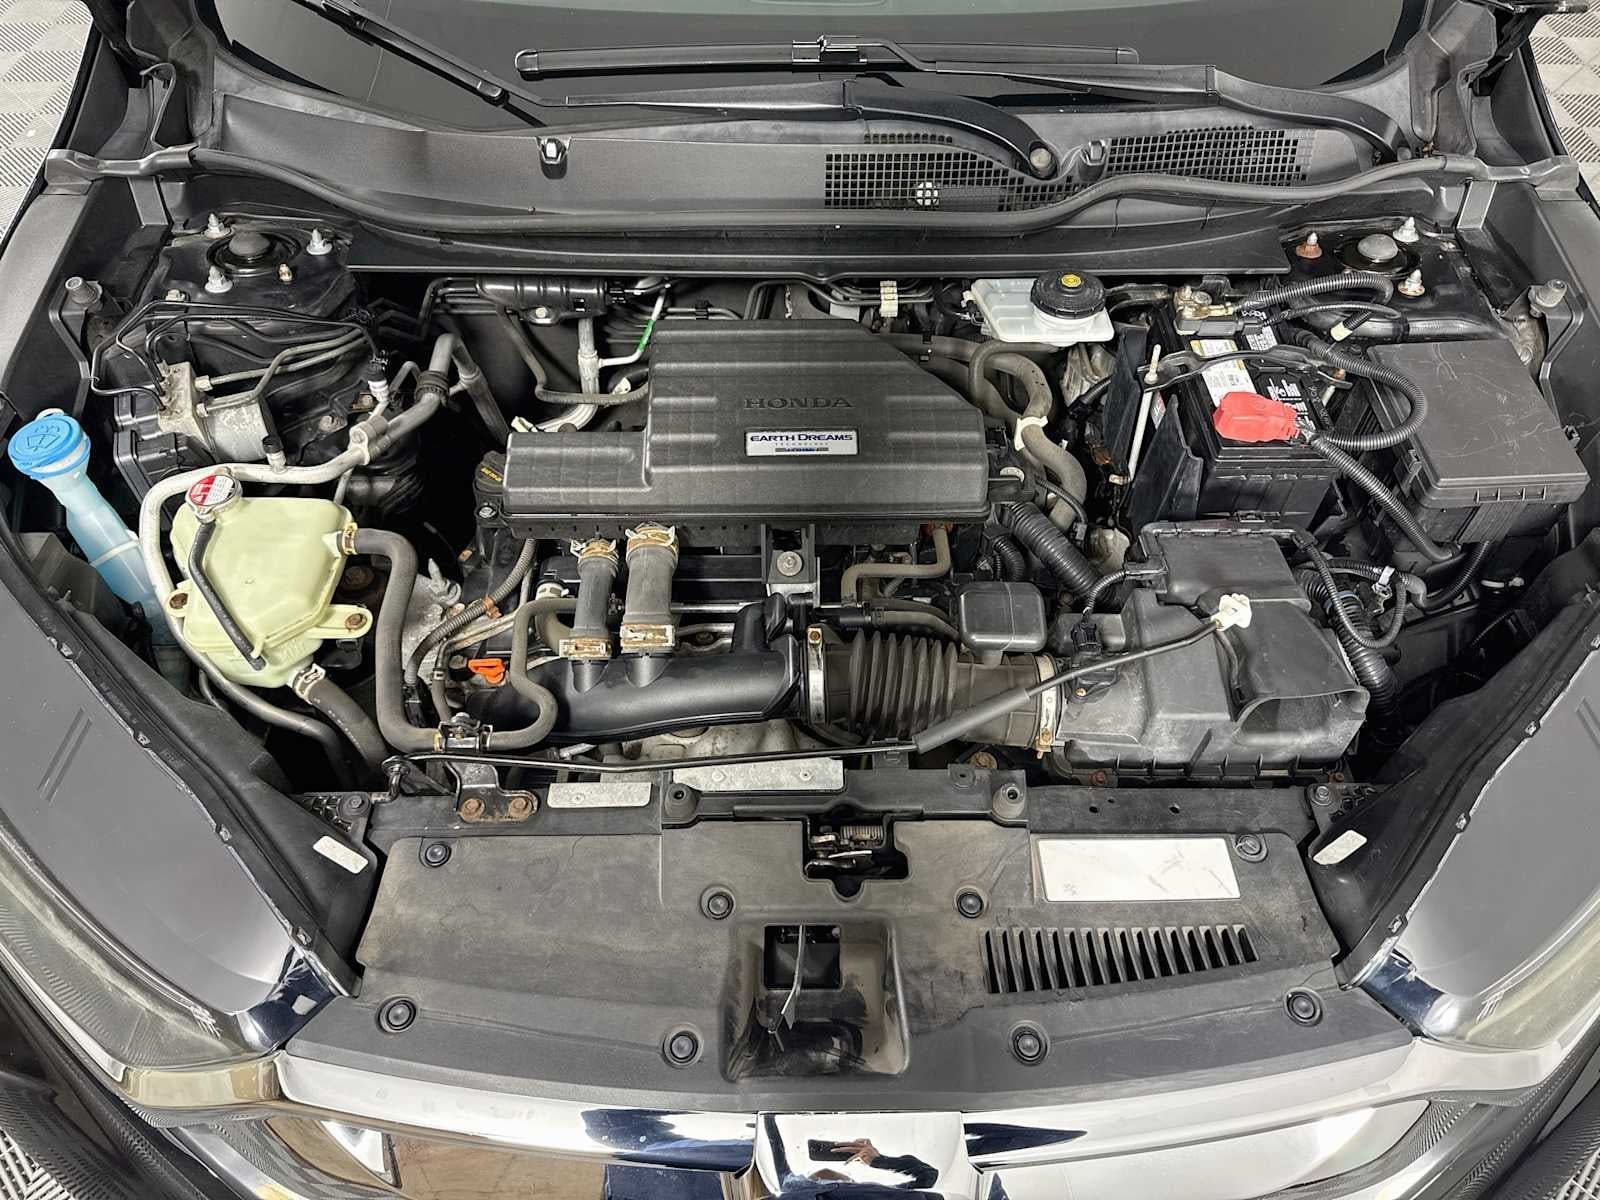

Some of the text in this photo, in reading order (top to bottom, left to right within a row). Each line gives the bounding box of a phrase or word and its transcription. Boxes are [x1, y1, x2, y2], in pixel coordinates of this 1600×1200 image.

[743, 397, 855, 409] HONDA
[750, 433, 853, 442] EARTH DREAMS
